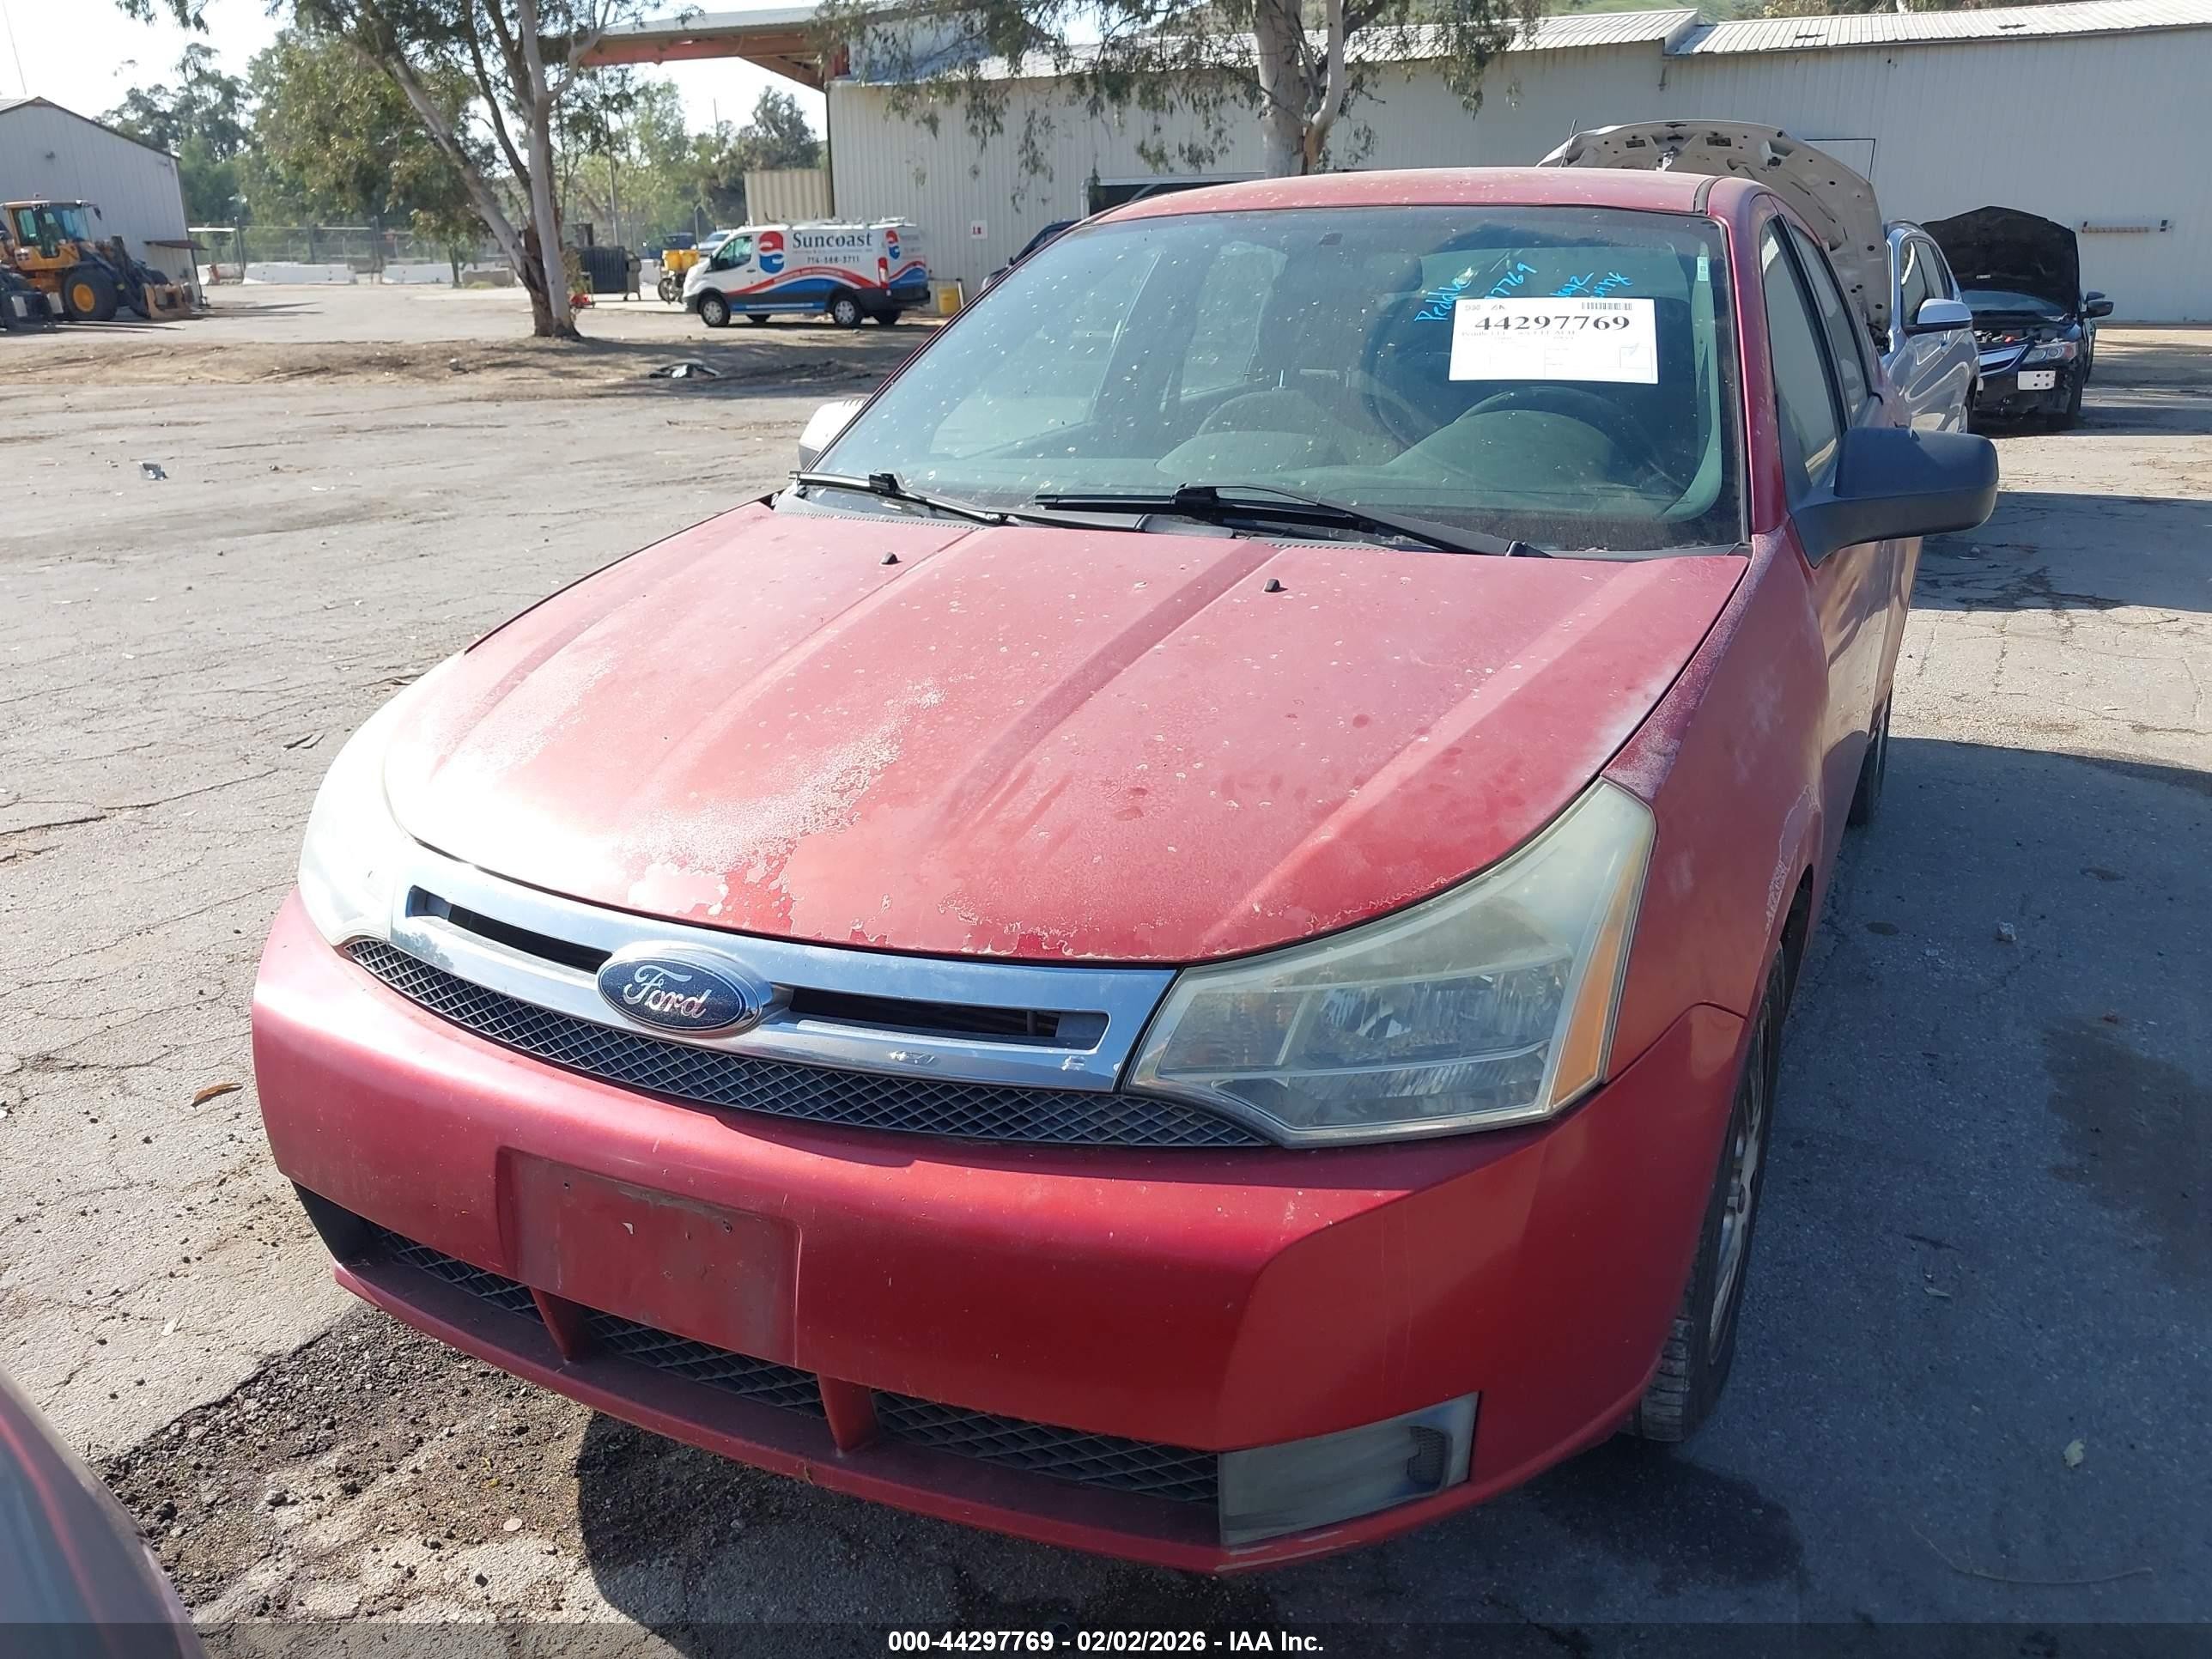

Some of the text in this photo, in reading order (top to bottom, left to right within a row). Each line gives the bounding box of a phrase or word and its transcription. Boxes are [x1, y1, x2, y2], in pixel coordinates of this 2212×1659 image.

[793, 232, 872, 248] Suncoast
[1486, 261, 1537, 299] 7769
[1474, 315, 1630, 331] 44297769
[623, 963, 713, 1018] Ford
